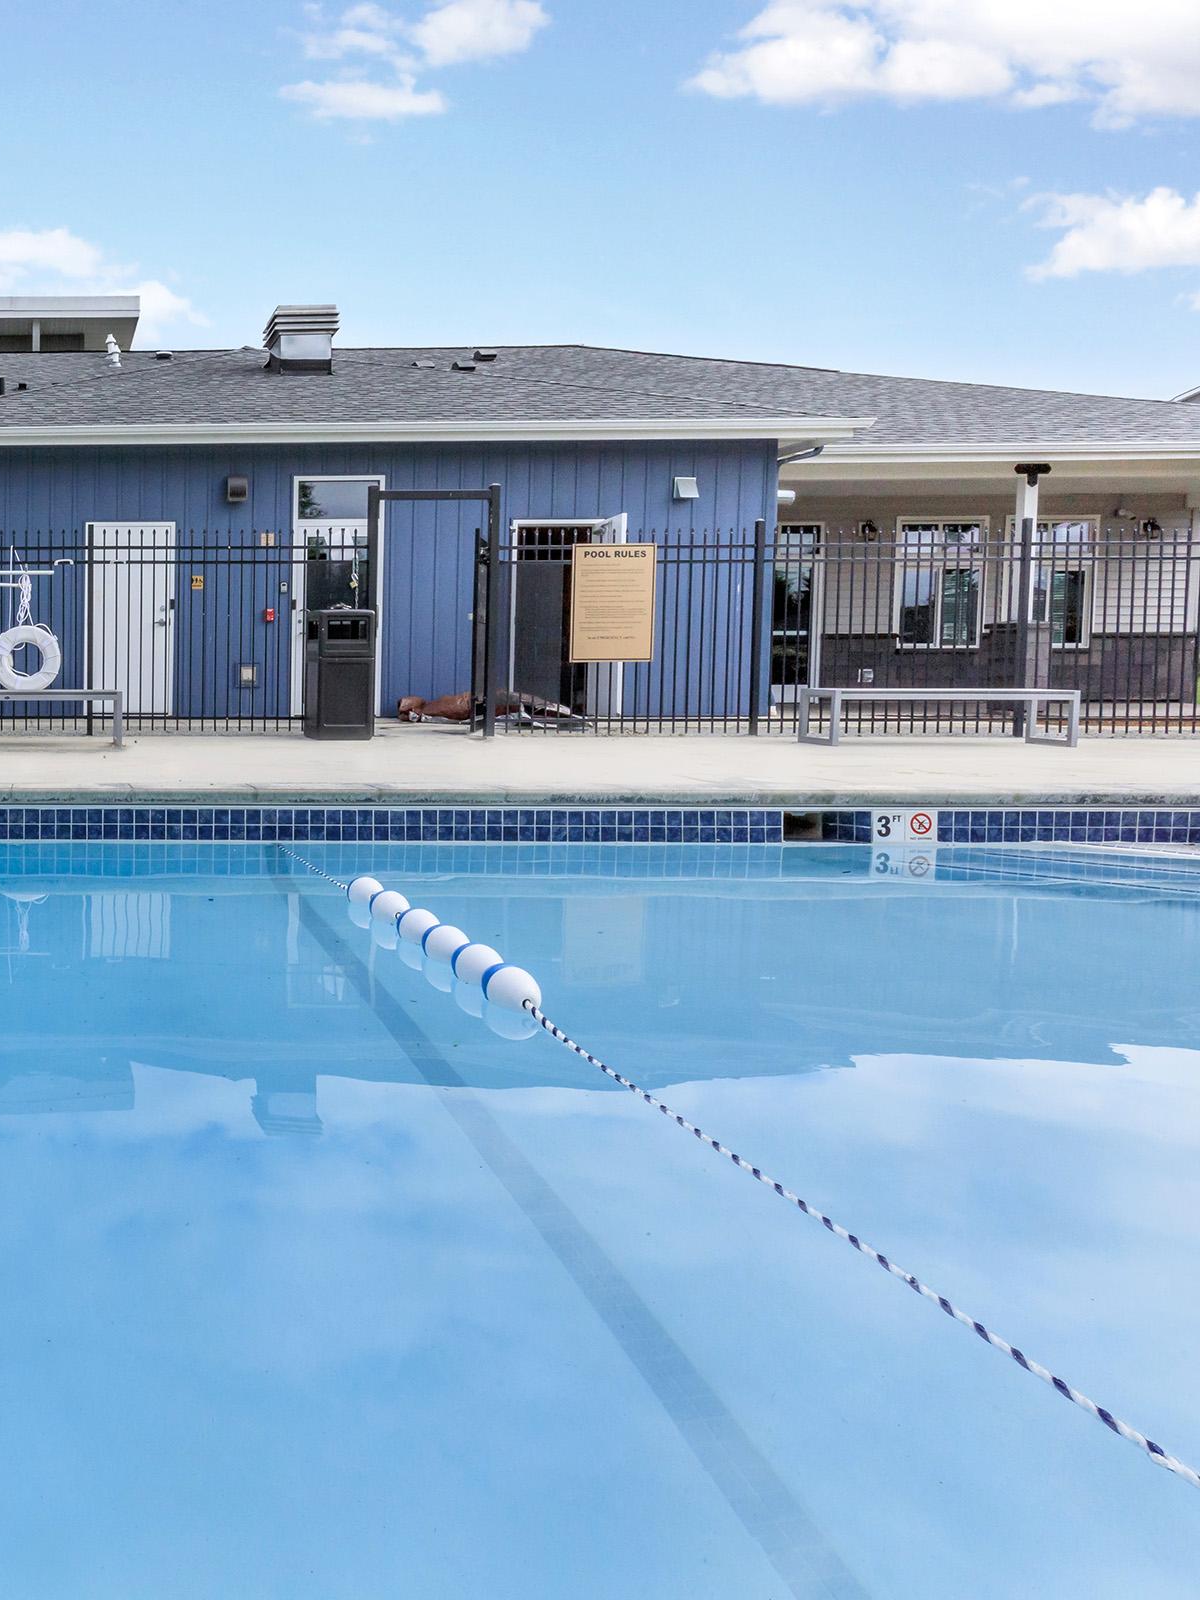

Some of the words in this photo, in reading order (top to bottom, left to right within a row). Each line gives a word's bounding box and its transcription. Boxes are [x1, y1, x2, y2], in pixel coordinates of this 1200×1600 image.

[584, 550, 611, 558] POOL
[614, 550, 647, 558] RULES
[877, 815, 891, 837] 3
